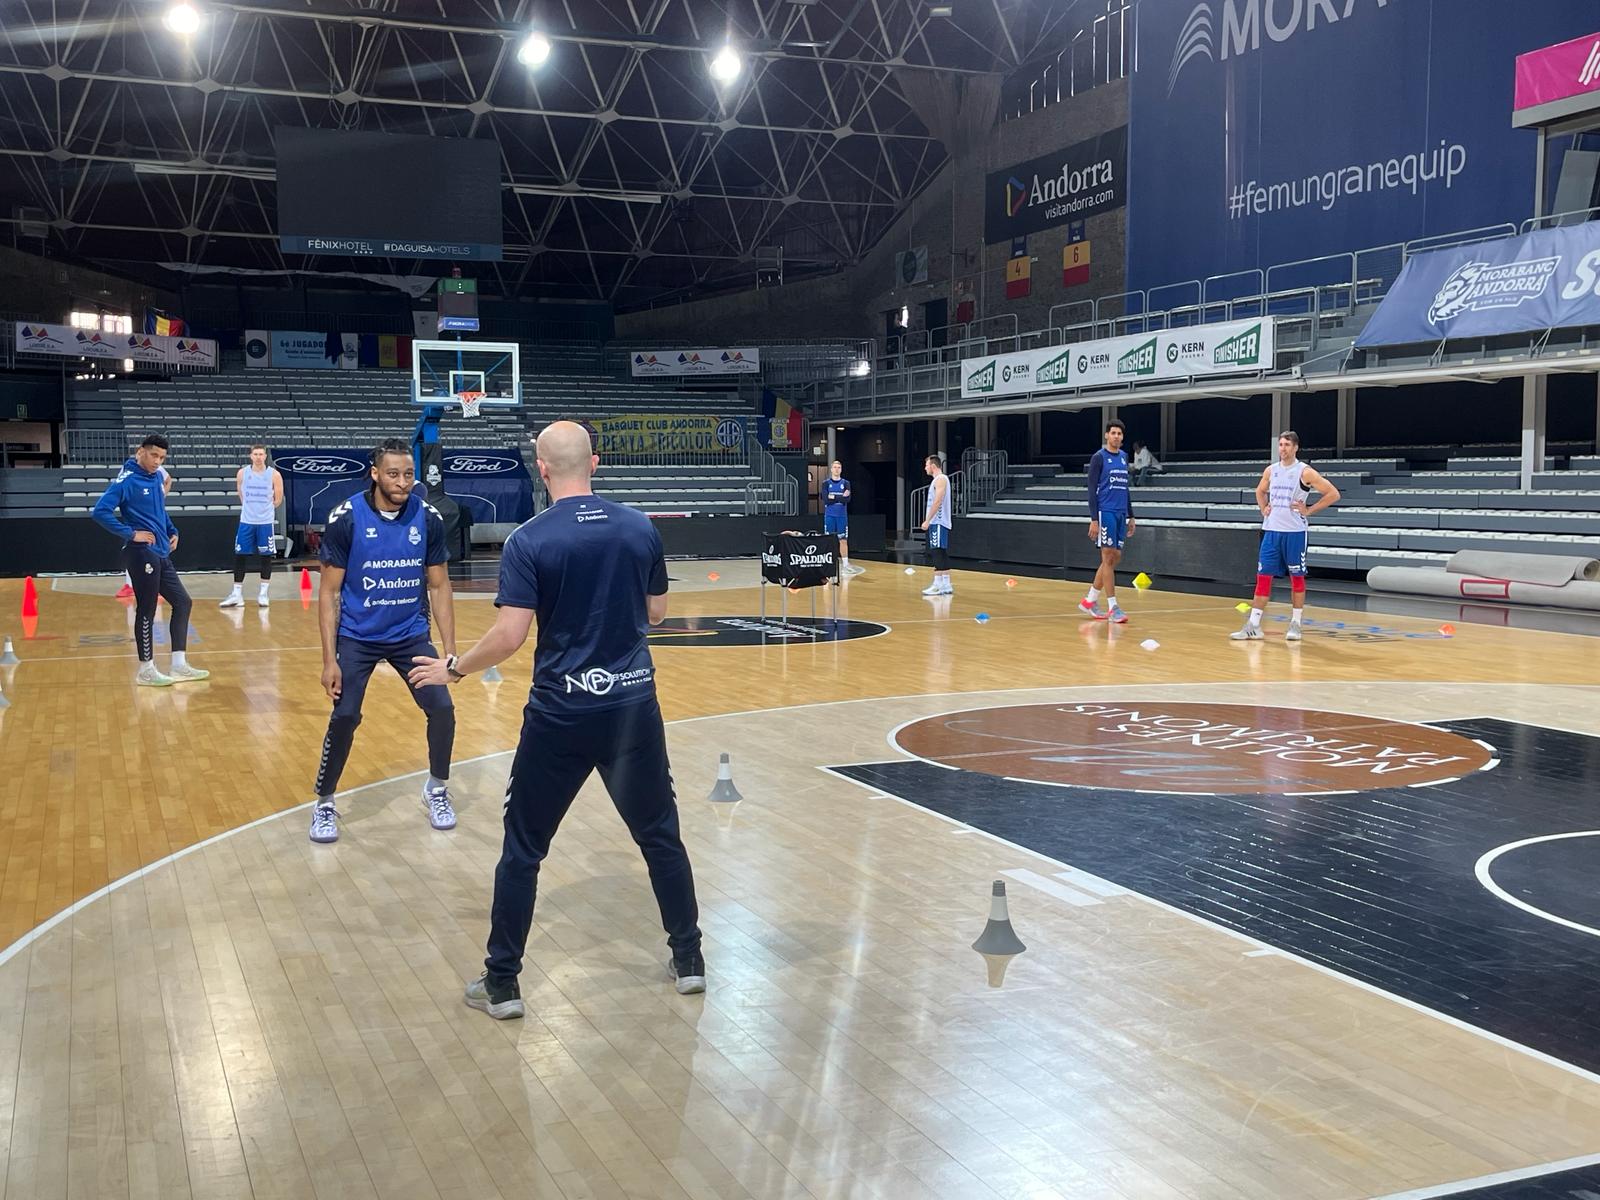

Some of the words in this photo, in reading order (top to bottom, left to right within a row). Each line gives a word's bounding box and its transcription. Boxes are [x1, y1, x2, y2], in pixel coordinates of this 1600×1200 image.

[1028, 160, 1113, 207] Andorra
[1230, 140, 1466, 219] #femungranequip
[1045, 189, 1113, 219] visitandorra.com
[1073, 246, 1079, 263] 6
[1015, 262, 1021, 276] 4
[1478, 260, 1555, 282] MORABANC
[1561, 248, 1600, 300] S
[1470, 275, 1545, 299] ANDORRA
[1013, 364, 1029, 374] KERN
[1090, 353, 1110, 365] KERN
[1118, 345, 1154, 373] FINISHER
[1181, 341, 1204, 353] KERN
[1215, 332, 1258, 363] FINISHER
[602, 420, 644, 433] BASQUET
[647, 419, 668, 430] CLUB
[671, 418, 713, 429] ANDORRA
[293, 459, 347, 472] Ford
[450, 458, 501, 471] Ford
[372, 558, 422, 569] MORABANC
[790, 552, 833, 566] SPALDING
[377, 577, 421, 589] Andorra
[1056, 704, 1470, 766] PATRIMONIS
[1097, 723, 1422, 774] MOLINES
